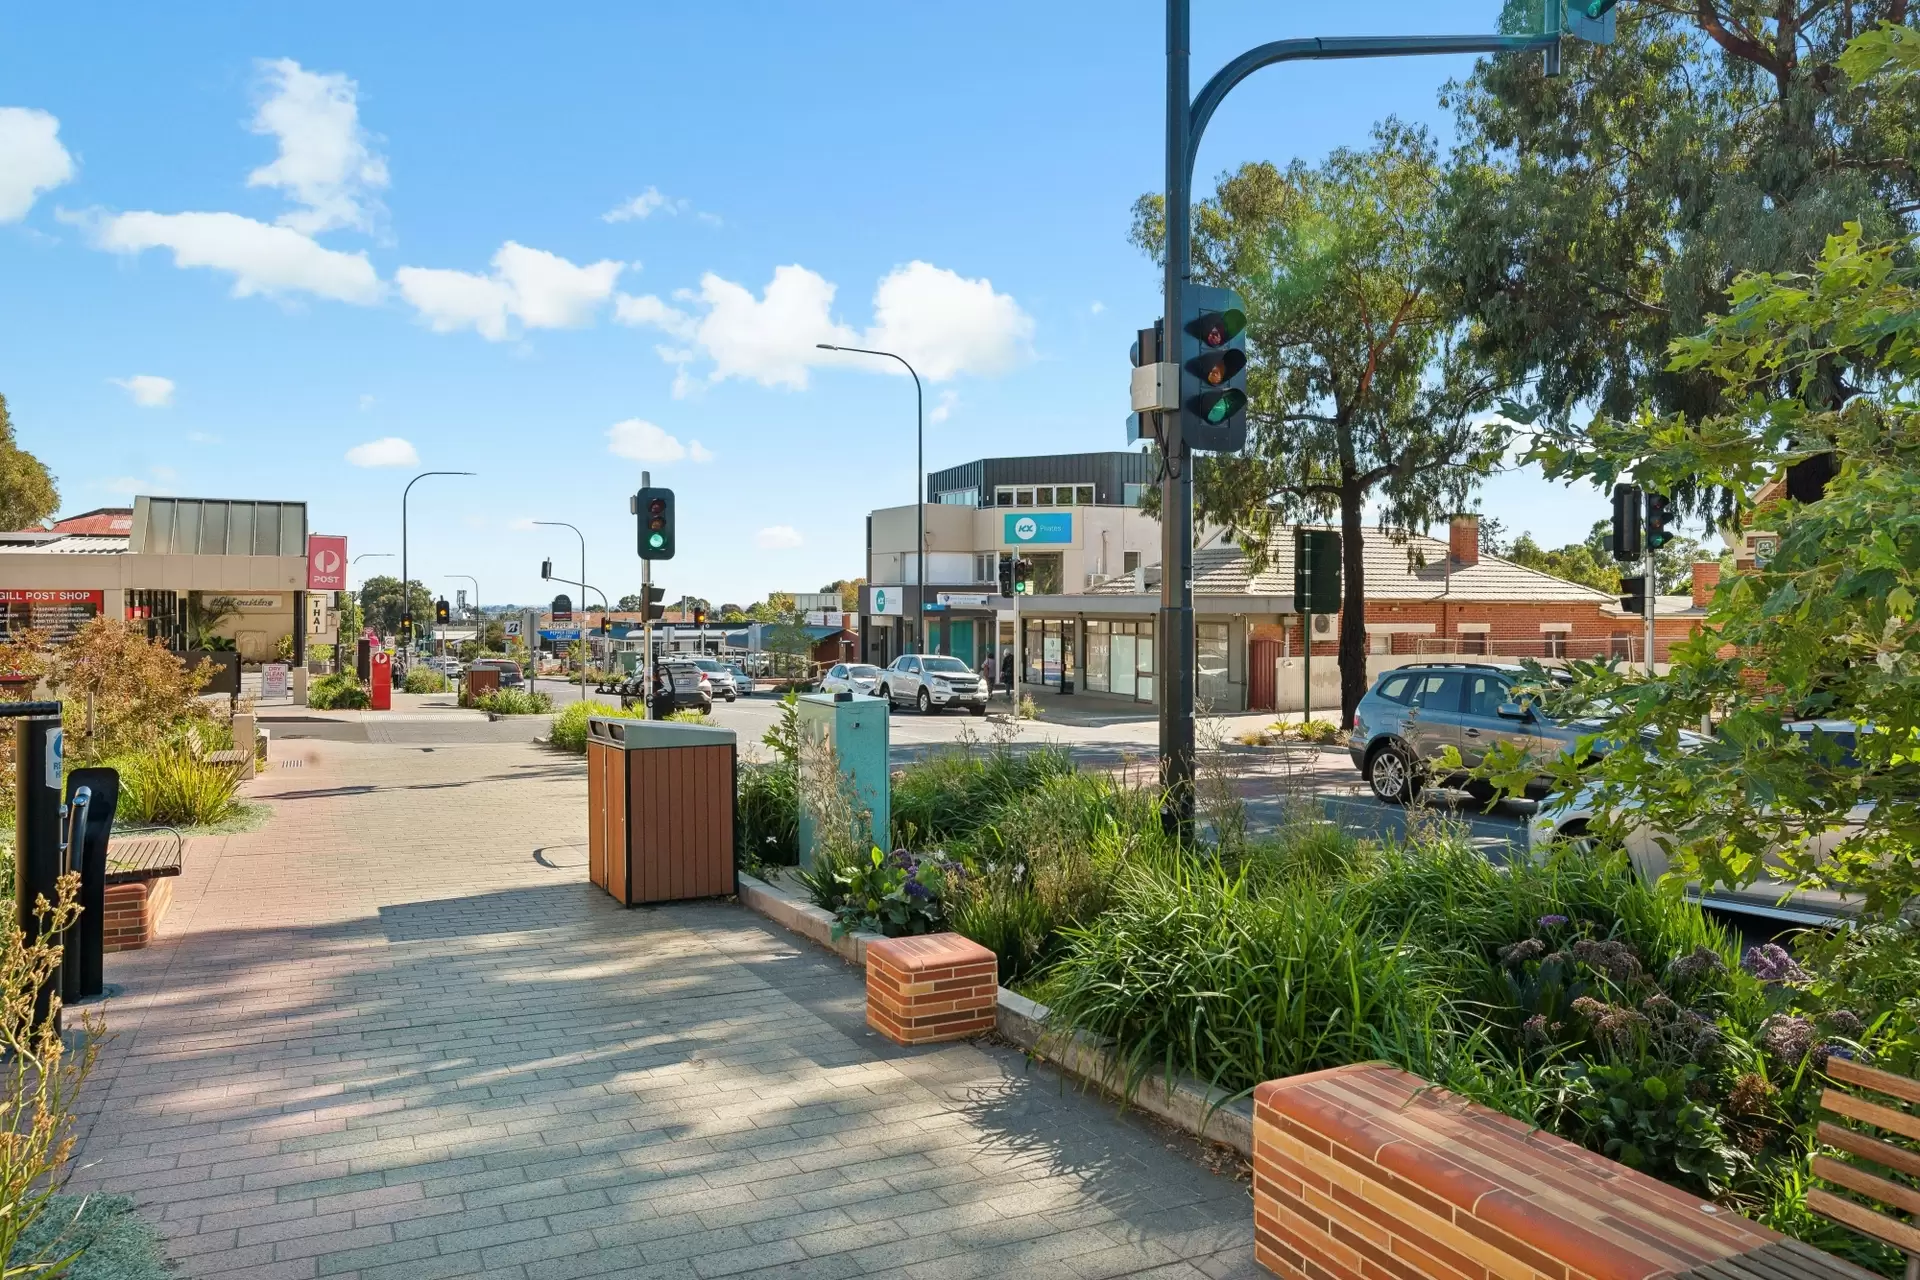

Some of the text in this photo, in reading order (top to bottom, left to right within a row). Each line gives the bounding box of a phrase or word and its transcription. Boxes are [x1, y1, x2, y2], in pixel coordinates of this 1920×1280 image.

[313, 575, 340, 583] POST
[26, 591, 56, 600] POST
[60, 591, 90, 600] SHOP
[313, 600, 321, 633] THAI
